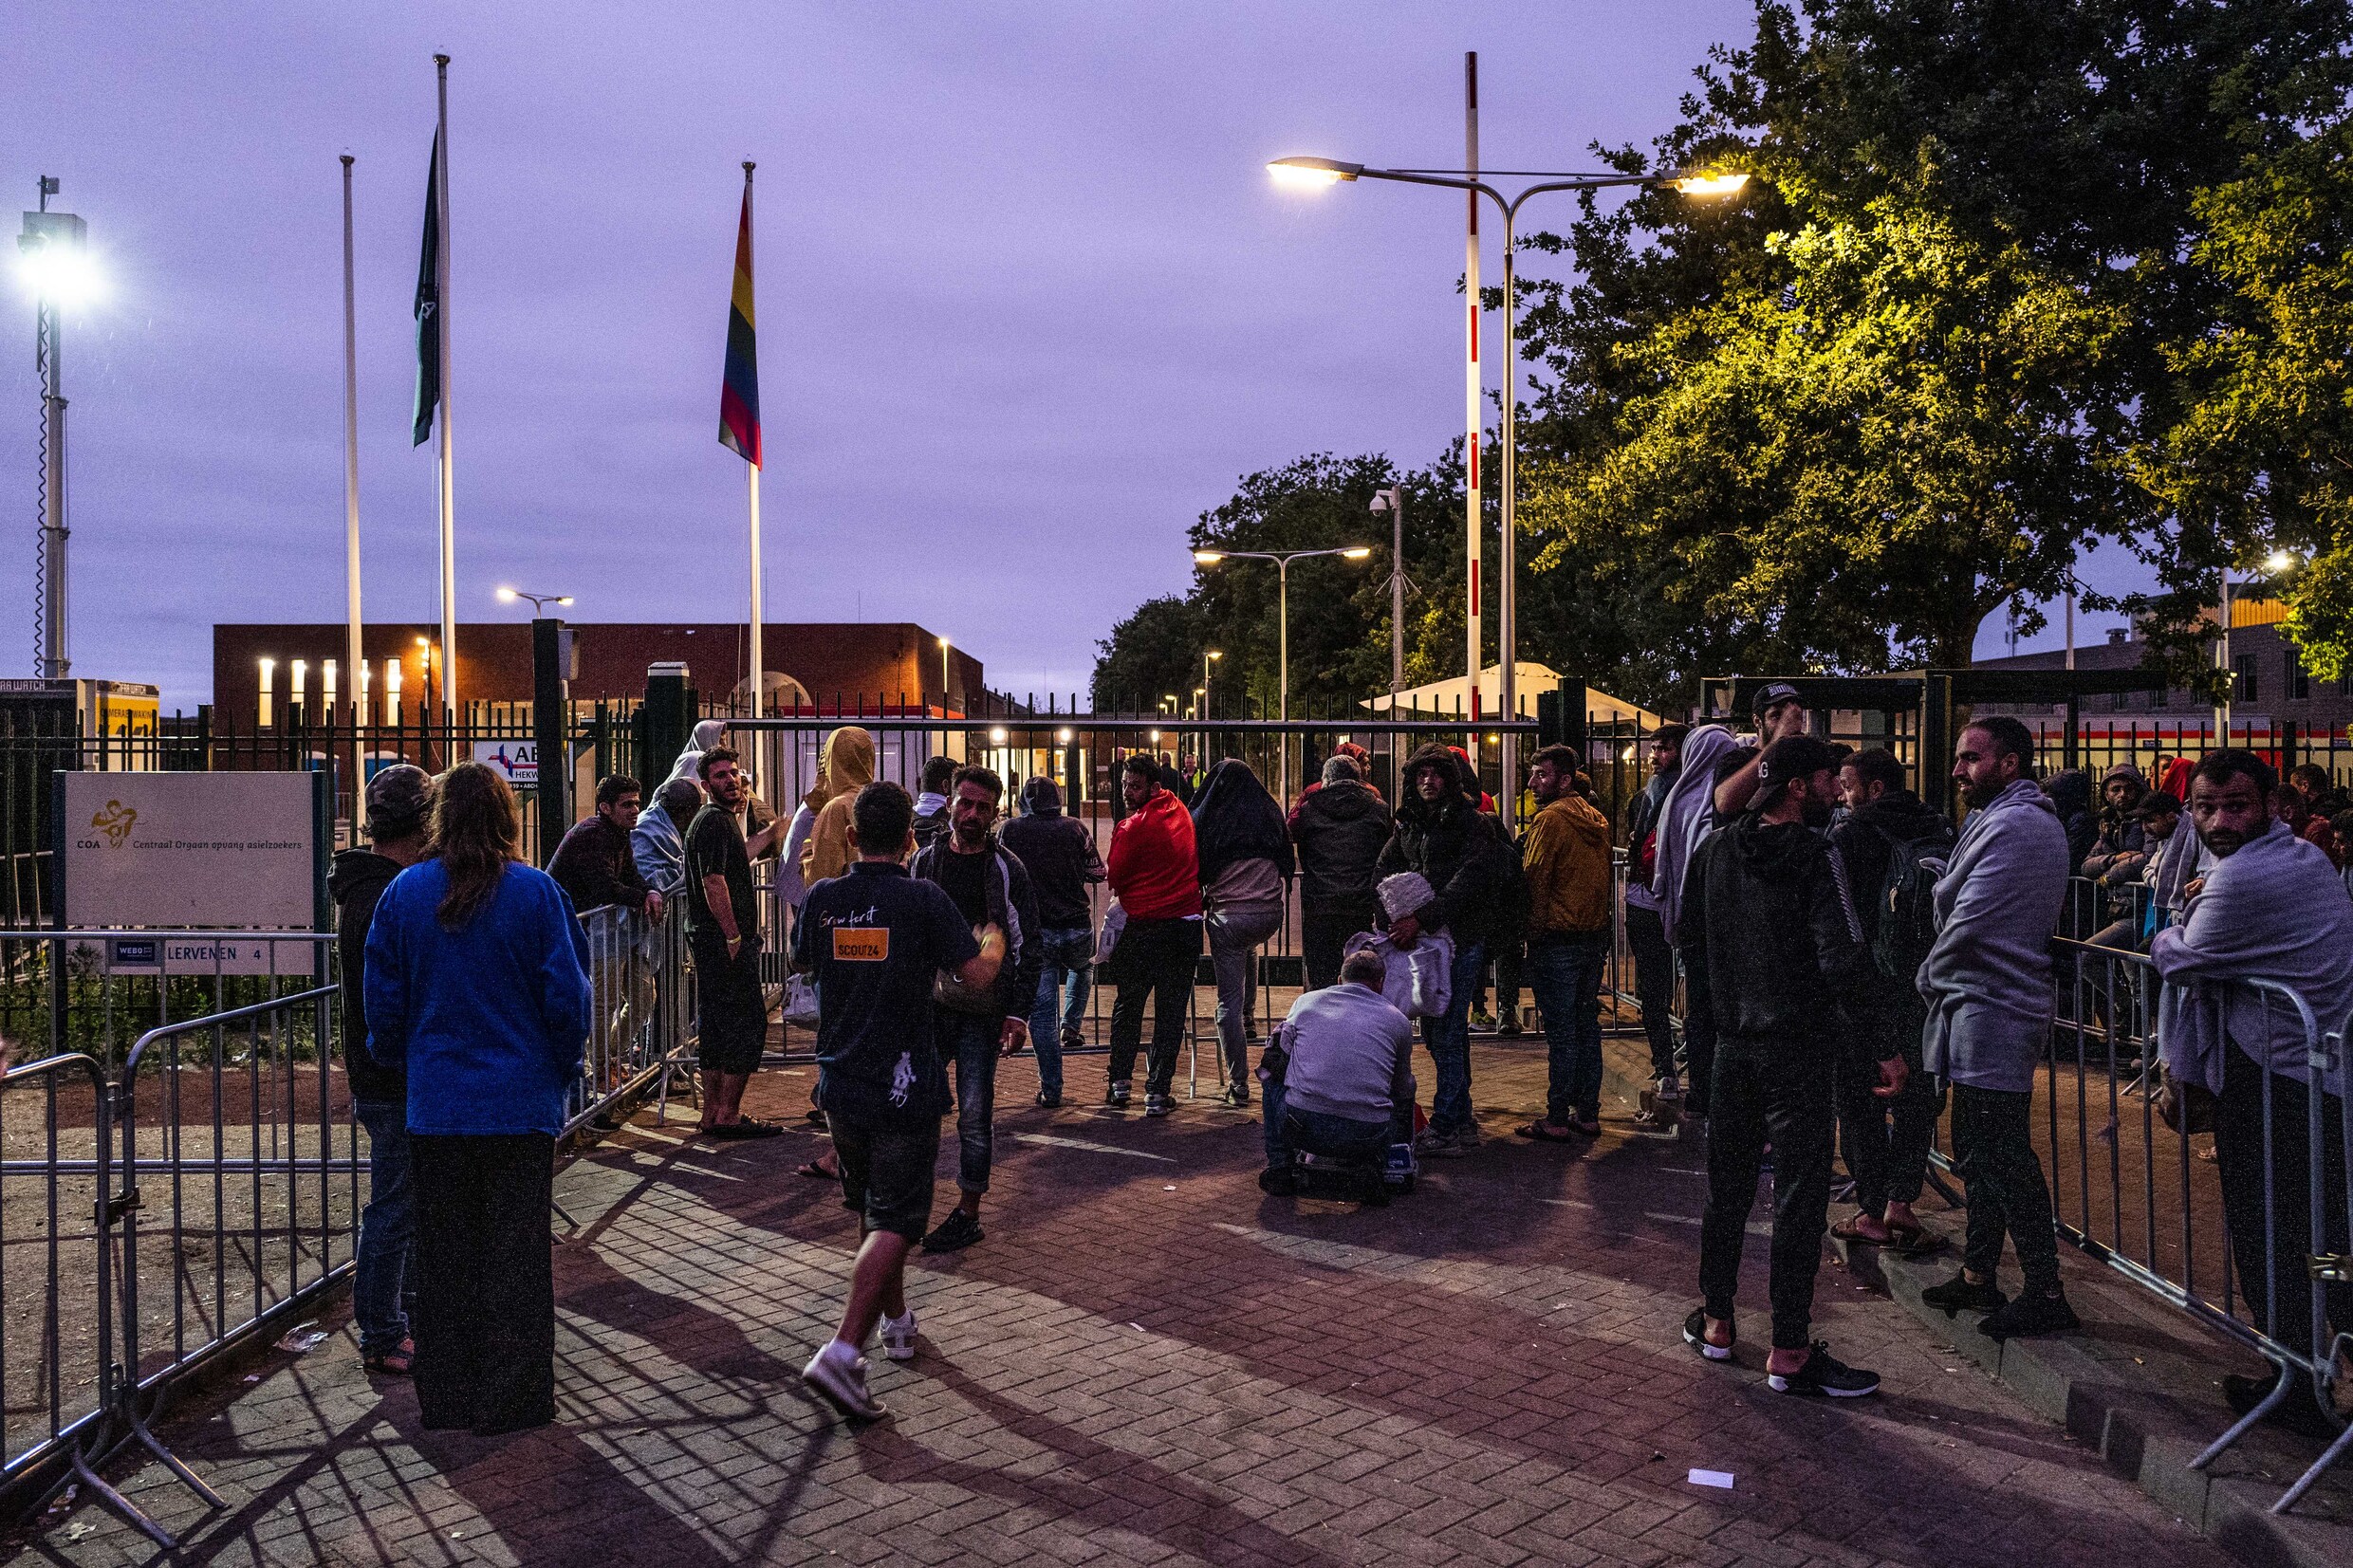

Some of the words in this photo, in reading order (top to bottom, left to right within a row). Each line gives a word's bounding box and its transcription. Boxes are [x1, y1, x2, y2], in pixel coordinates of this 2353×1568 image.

[13, 680, 46, 692] WATCH
[77, 840, 101, 850] COA
[133, 839, 173, 850] Centraal
[175, 840, 210, 852] Orgaan
[212, 840, 245, 852] opvang
[247, 839, 303, 850] asielzoekers
[819, 910, 846, 928] Grow
[253, 950, 261, 960] 4
[839, 945, 880, 956] SCOUT24
